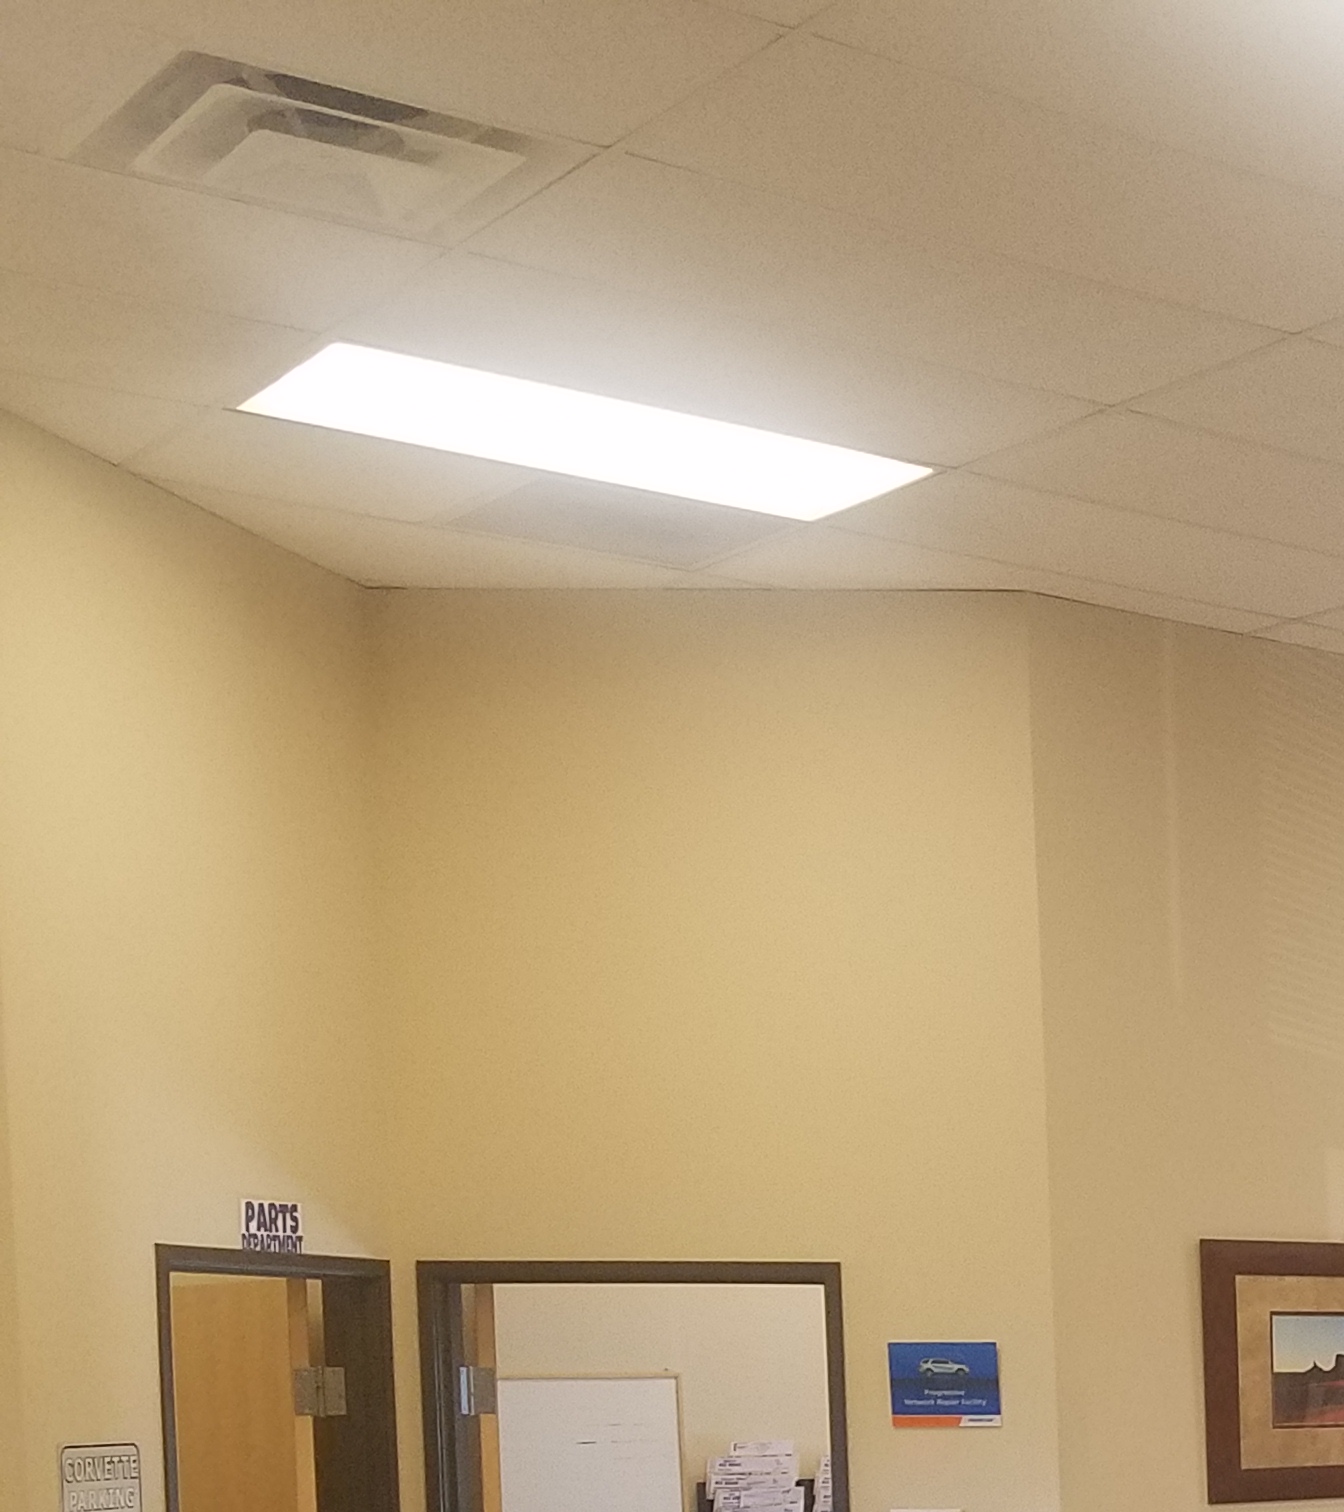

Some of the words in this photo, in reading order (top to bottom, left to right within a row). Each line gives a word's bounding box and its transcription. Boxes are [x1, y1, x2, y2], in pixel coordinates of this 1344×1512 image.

[245, 1201, 299, 1234] PARTS
[65, 1455, 139, 1483] CORVETTE
[68, 1487, 134, 1512] PARKING
